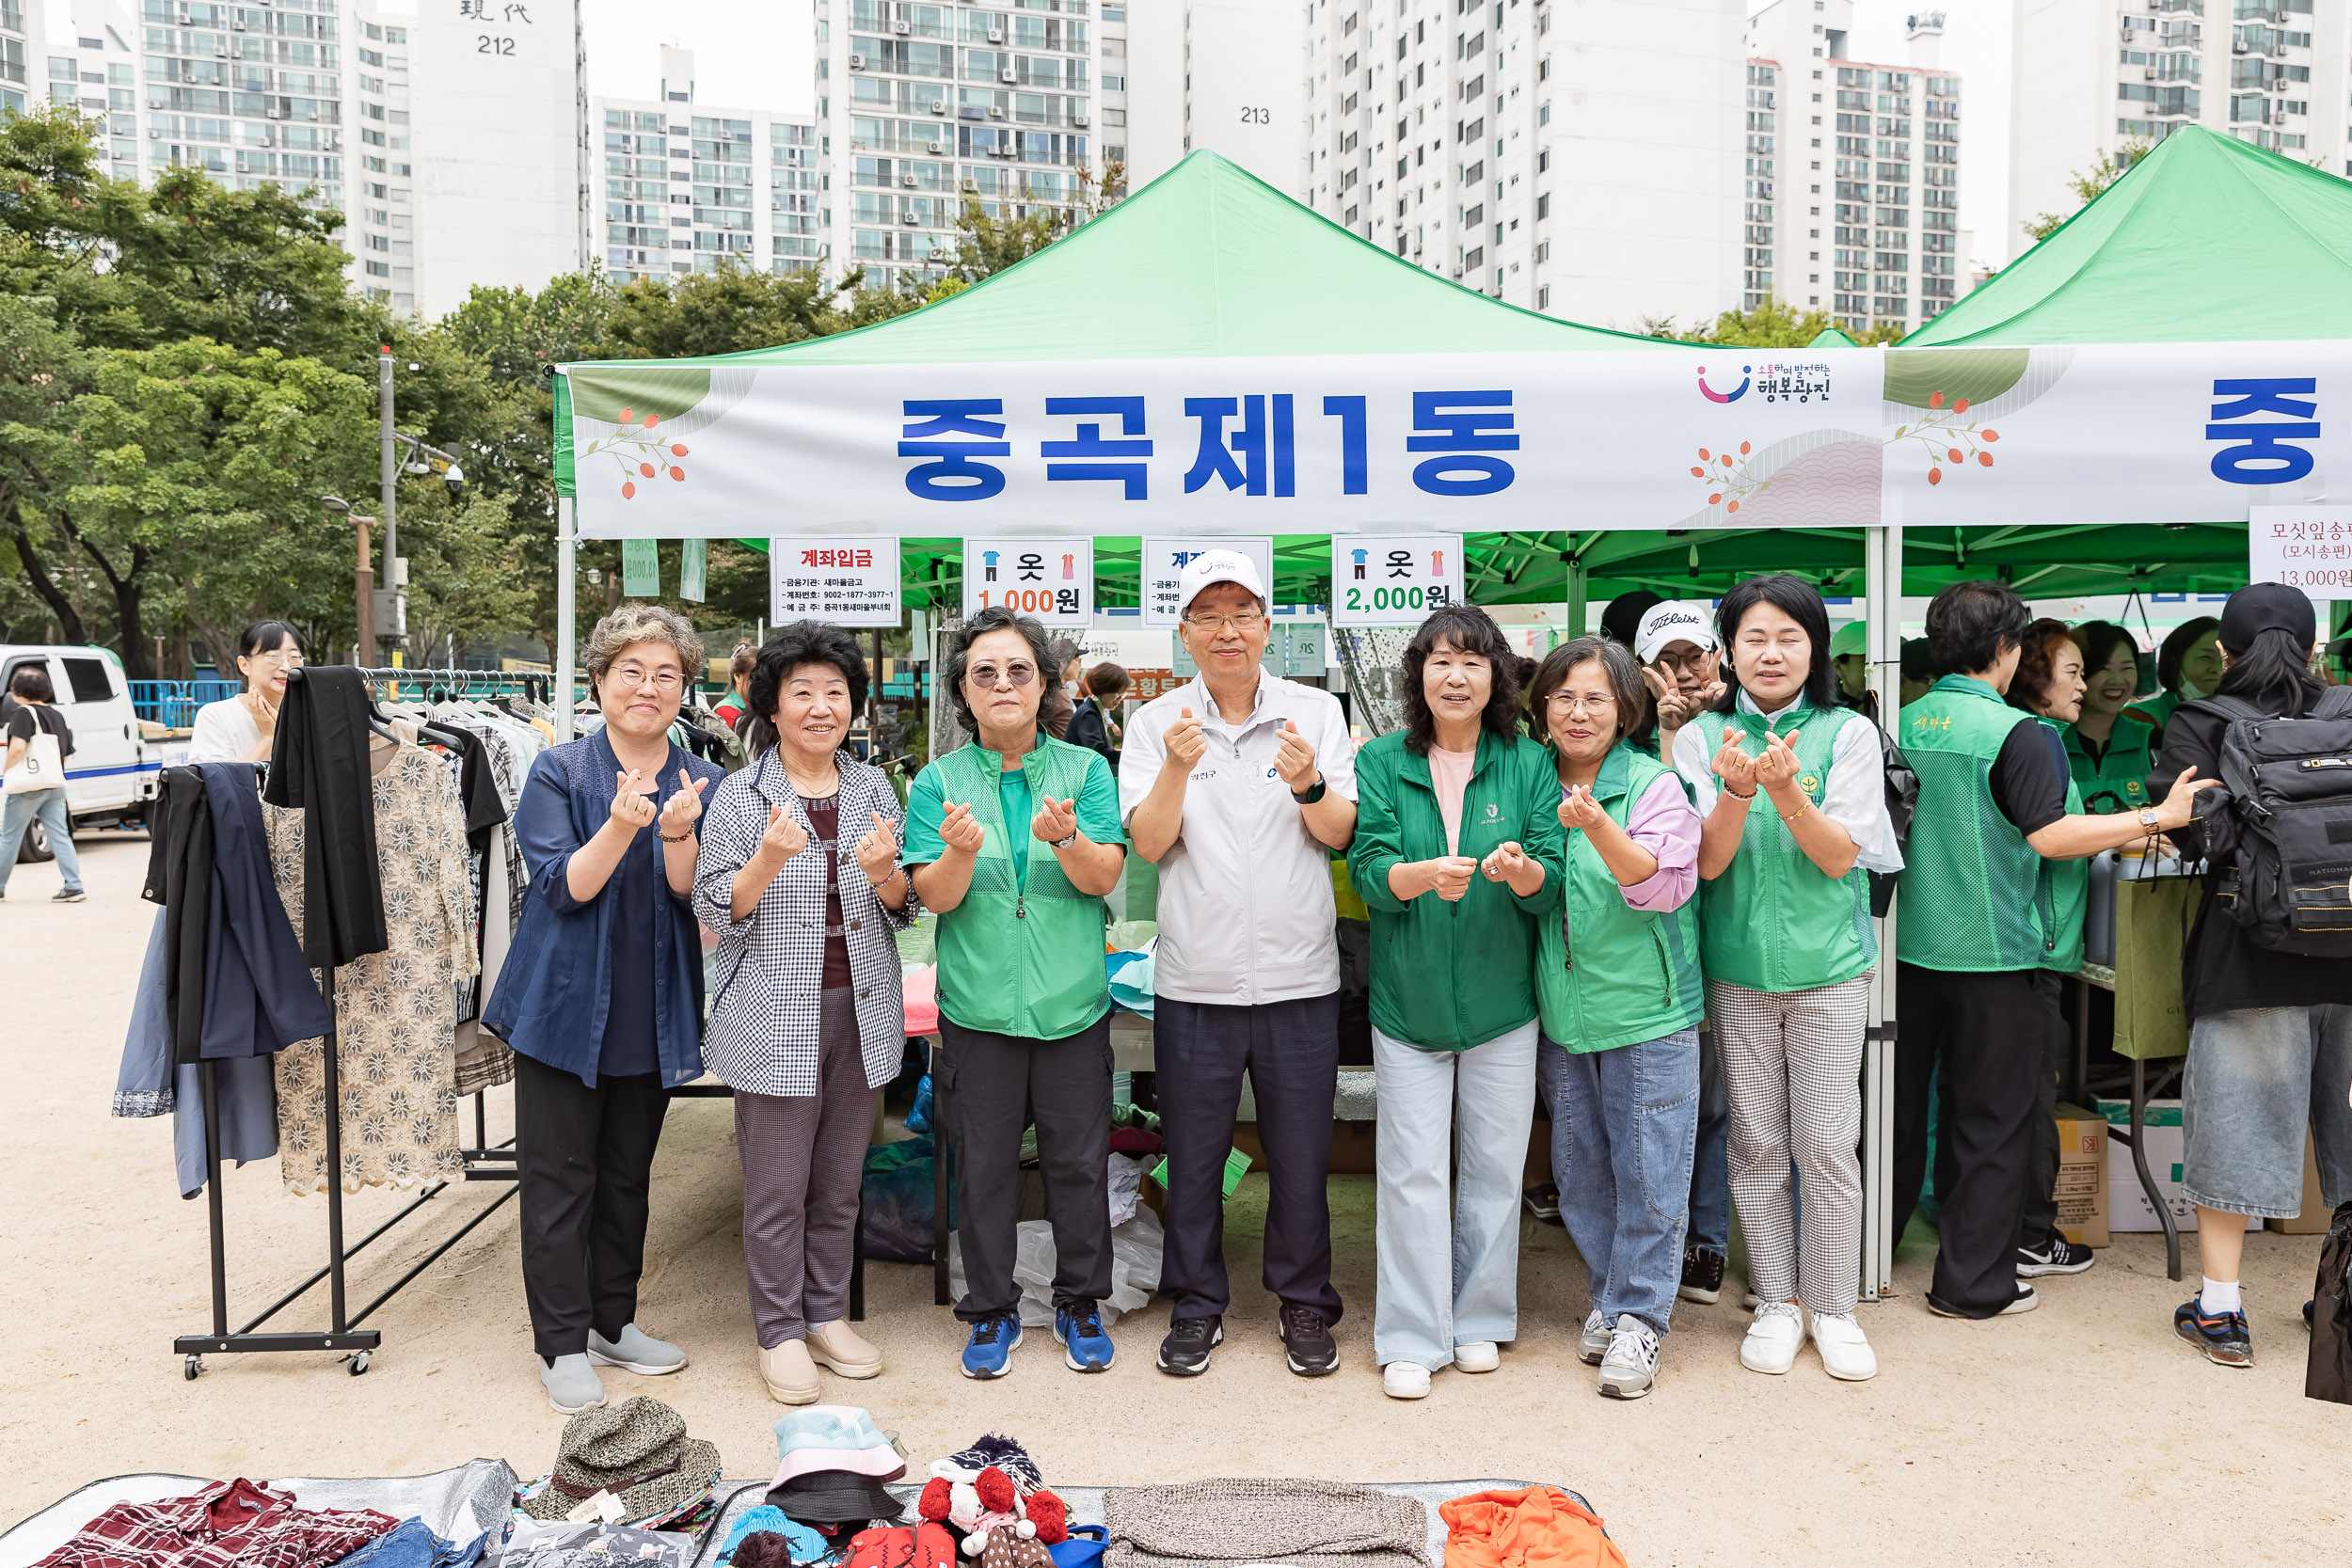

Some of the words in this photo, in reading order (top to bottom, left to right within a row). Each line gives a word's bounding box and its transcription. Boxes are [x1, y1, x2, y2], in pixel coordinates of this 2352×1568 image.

[460, 0, 532, 24] 現代
[478, 35, 516, 55] 212
[1241, 106, 1270, 124] 213
[1757, 363, 1792, 379] 소통하며
[1795, 363, 1831, 379] 발전하는
[1757, 377, 1830, 404] 행복광진
[2205, 378, 2321, 484] 중
[898, 389, 1520, 501] 중곡제1동
[801, 549, 873, 567] 계좌입금
[1386, 550, 1414, 578] 옷
[2282, 544, 2352, 560] (모시송편)
[1017, 553, 1045, 581] 옷
[2280, 569, 2352, 588] 13,000원
[824, 578, 864, 587] 새마을금고
[823, 591, 894, 599] 9002-1877-3977-1
[978, 588, 1080, 614] 1000원
[1346, 584, 1450, 613] 2,000원
[1646, 612, 1700, 637] Titleist
